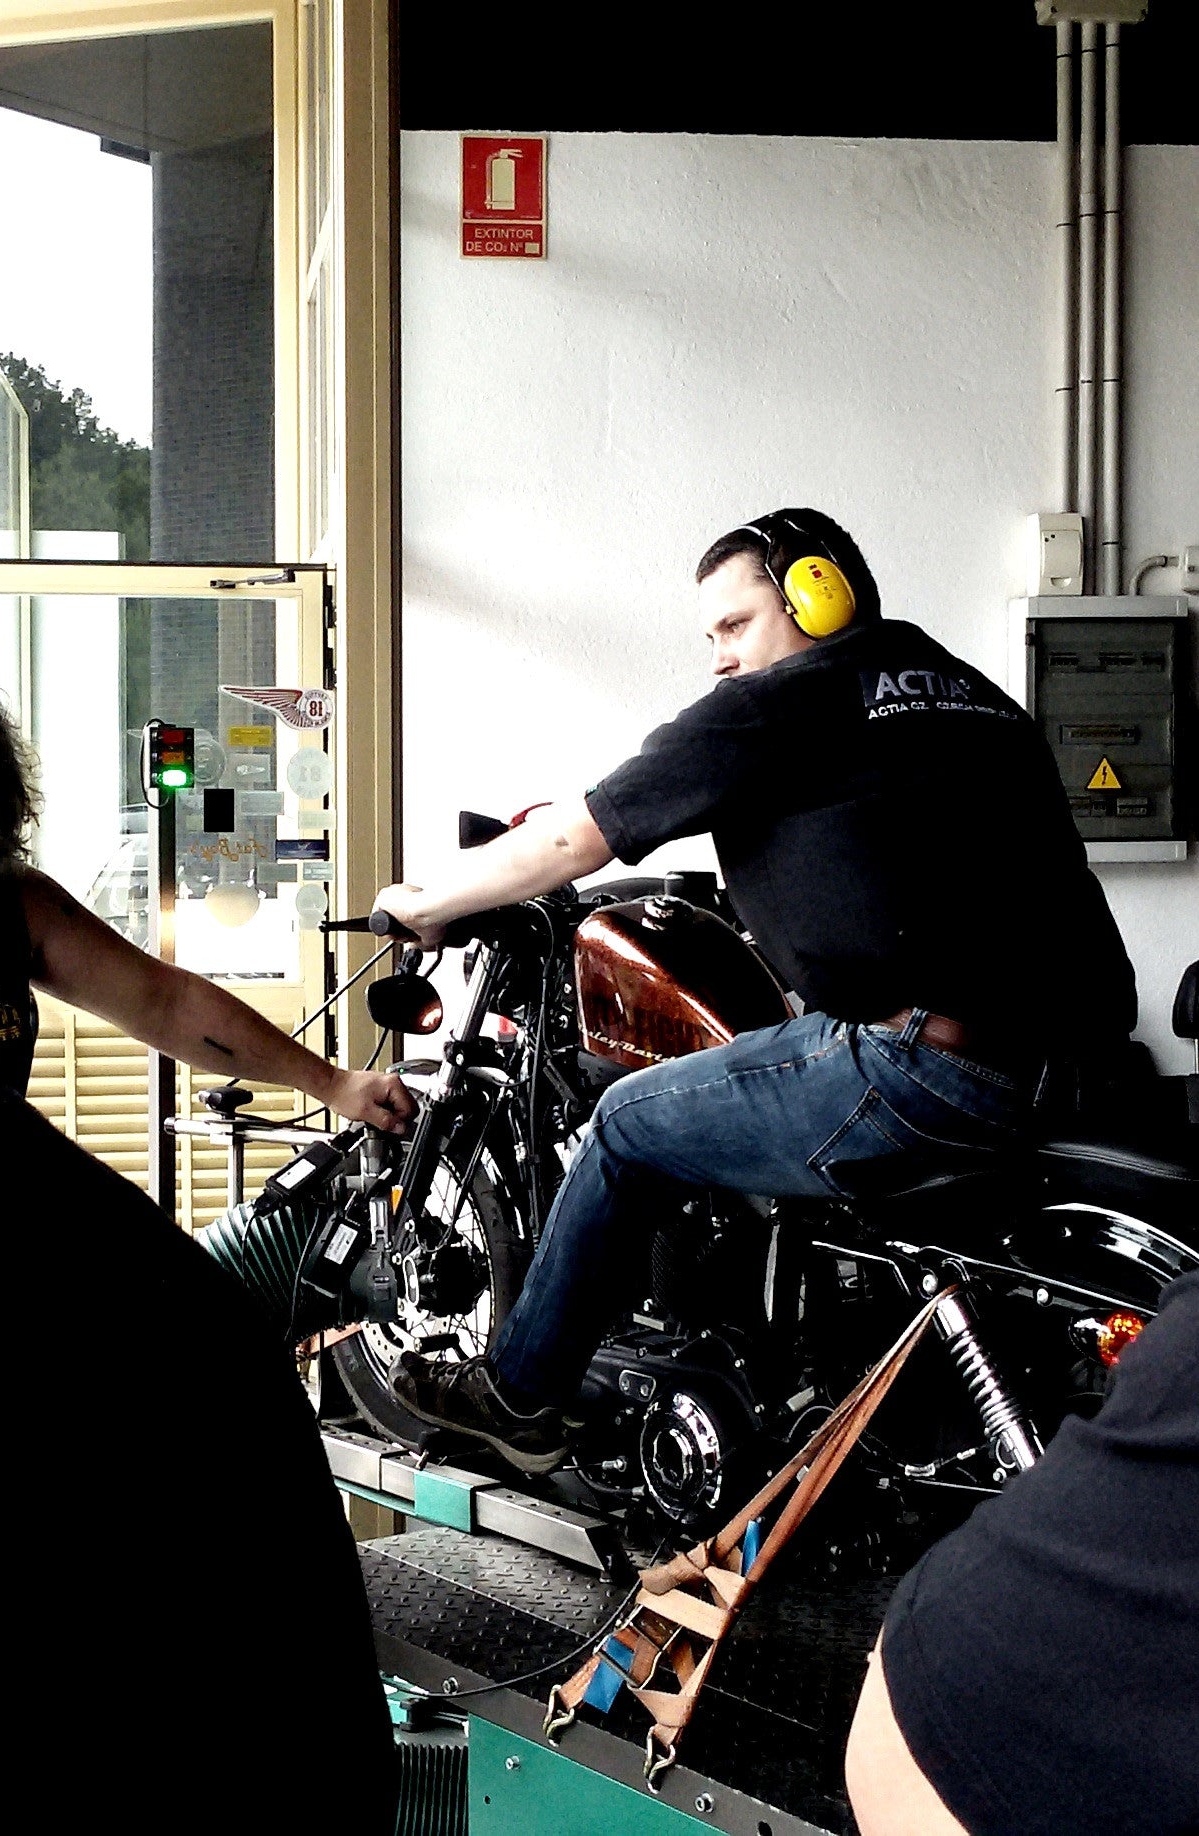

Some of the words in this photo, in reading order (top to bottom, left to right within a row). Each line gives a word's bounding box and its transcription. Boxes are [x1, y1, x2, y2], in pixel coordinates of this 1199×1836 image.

[474, 228, 534, 240] EXTINTOR
[466, 241, 482, 252] DE
[874, 670, 969, 700] ACTIA
[309, 700, 323, 717] 81
[868, 702, 909, 720] ACTIA
